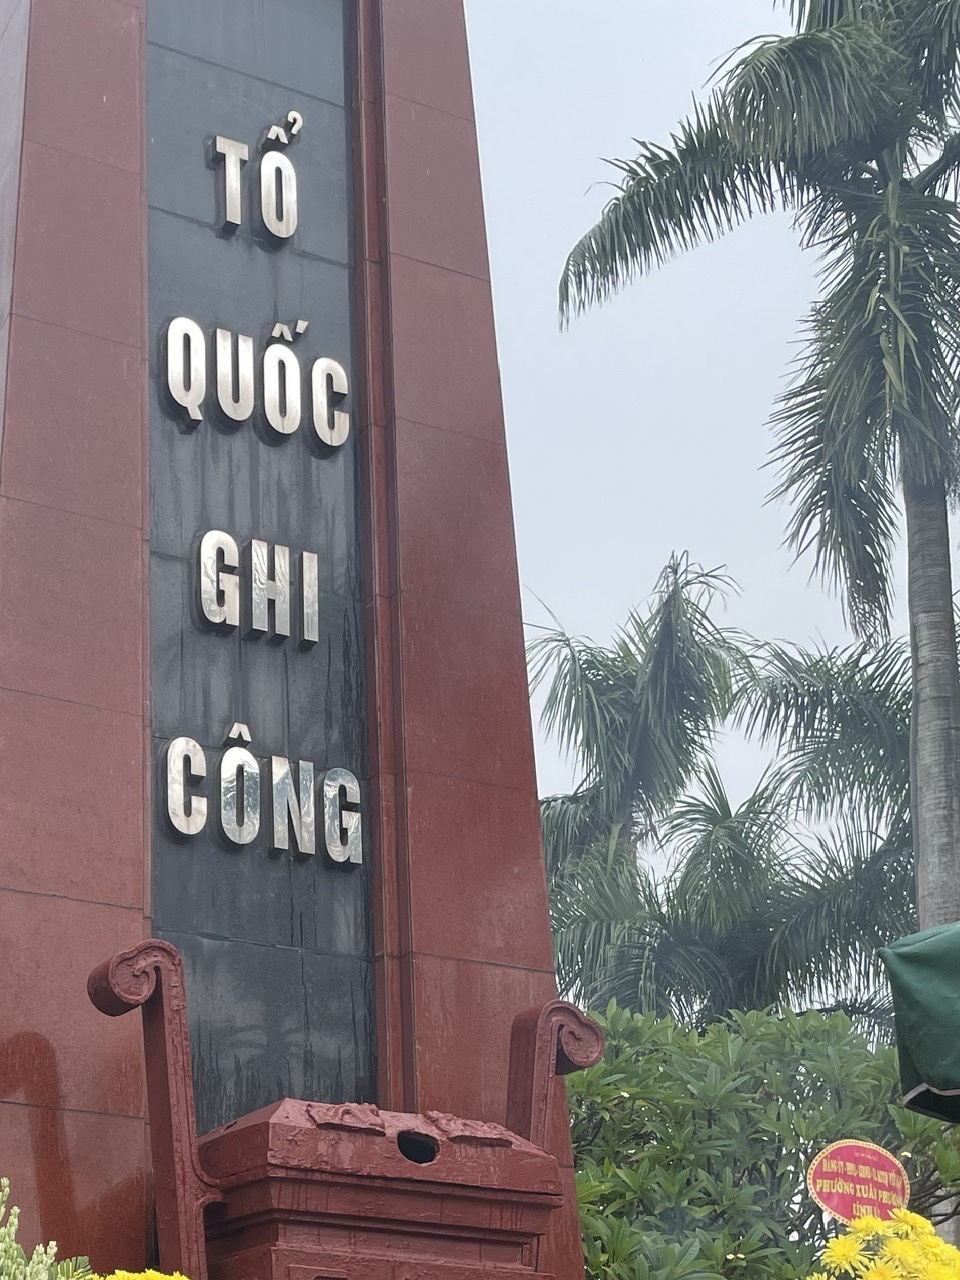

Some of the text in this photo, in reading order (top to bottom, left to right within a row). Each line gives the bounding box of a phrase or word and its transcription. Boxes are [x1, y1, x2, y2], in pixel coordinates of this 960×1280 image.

[212, 110, 304, 240] TỔ
[166, 315, 351, 448] QUỐC
[199, 529, 320, 648] GHI
[166, 721, 364, 866] CÔNG
